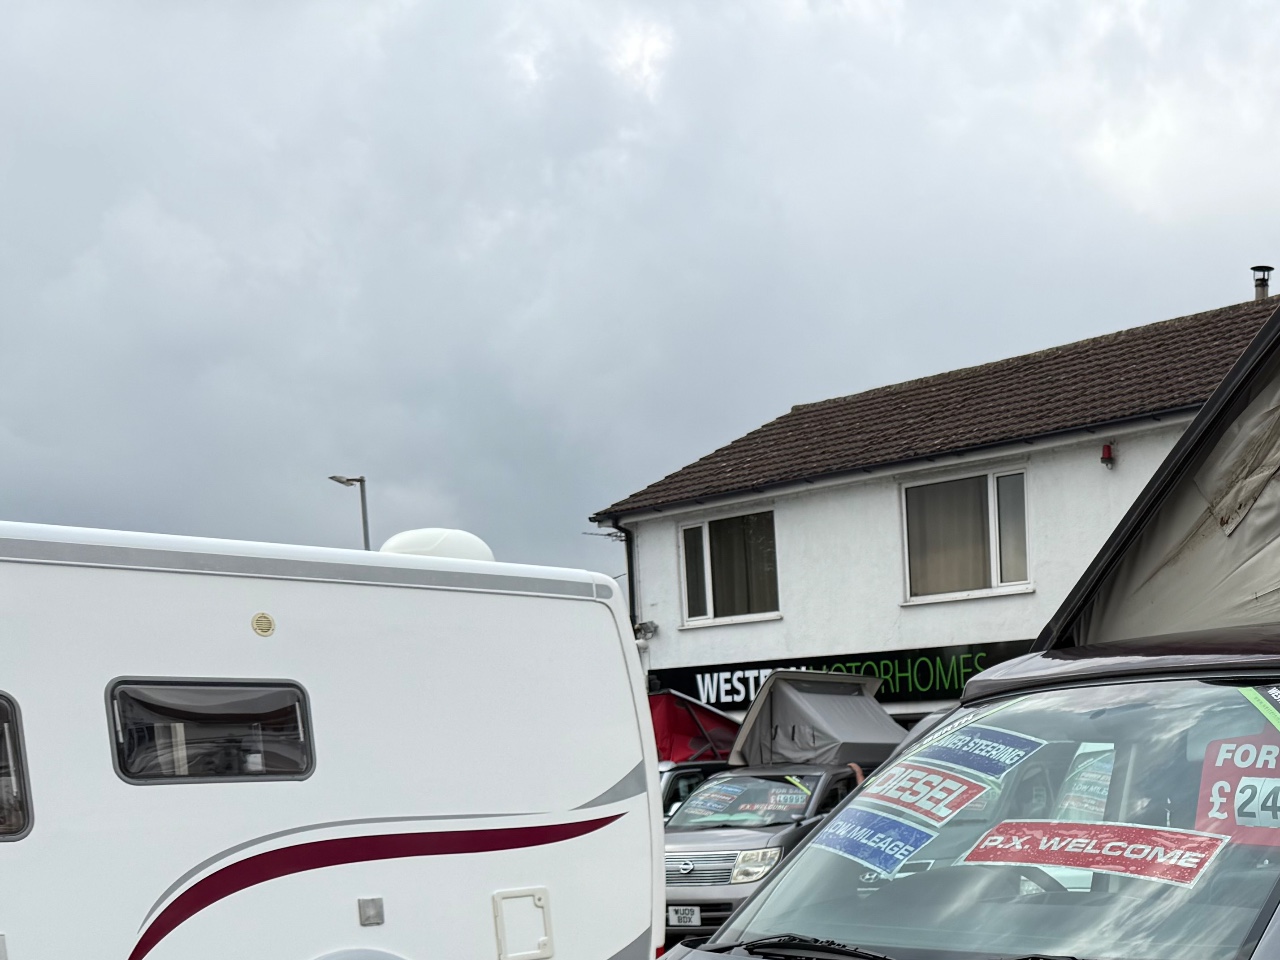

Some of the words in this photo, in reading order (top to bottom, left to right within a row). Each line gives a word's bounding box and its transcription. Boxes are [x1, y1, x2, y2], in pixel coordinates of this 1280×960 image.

[962, 738, 1026, 765] STEERING
[1214, 743, 1280, 769] FOR
[867, 765, 969, 818] DIESEL
[847, 825, 916, 860] MILEAGE
[980, 835, 1031, 850] P.X.
[1038, 836, 1206, 869] WELCOME
